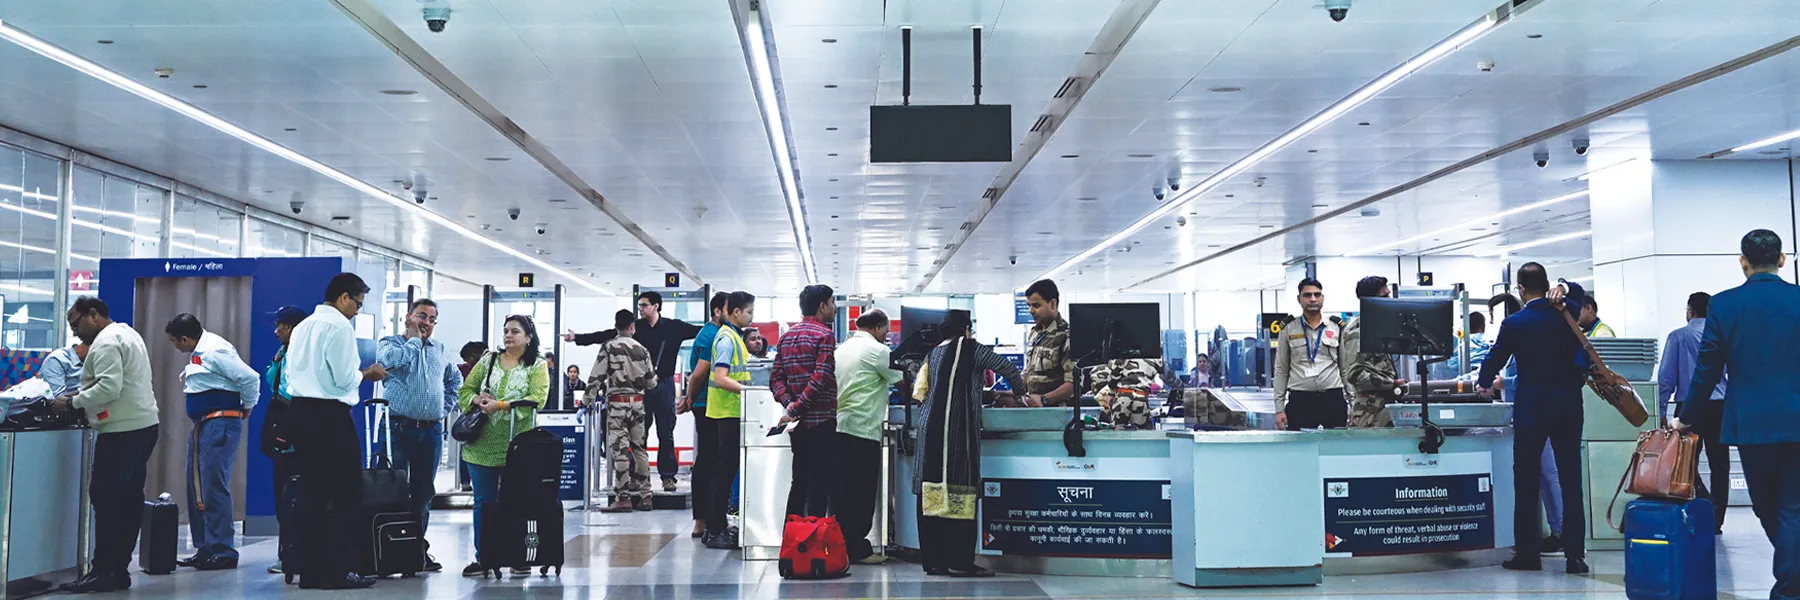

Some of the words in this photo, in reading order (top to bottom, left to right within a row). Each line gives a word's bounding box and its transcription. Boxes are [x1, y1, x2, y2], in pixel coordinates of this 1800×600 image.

[204, 261, 224, 270] महिला
[522, 276, 529, 284] R
[669, 276, 676, 284] Q
[1270, 320, 1280, 334] 6
[1056, 486, 1094, 502] सूचना
[1395, 486, 1448, 498] Information
[1008, 510, 1022, 518] कृपया
[1025, 510, 1039, 518] सुरक्षा
[1071, 510, 1078, 518] के
[1095, 510, 1112, 518] विनम्र
[1338, 508, 1361, 516] Please
[1362, 508, 1372, 516] be
[1372, 507, 1405, 516] courteous
[1406, 506, 1422, 514] when
[1424, 504, 1444, 514] dealing
[1445, 504, 1456, 512] with
[1457, 503, 1476, 512] security
[1476, 502, 1486, 510] staff
[1029, 524, 1036, 532] की
[1136, 527, 1142, 535] के
[1354, 527, 1368, 536] Any
[1368, 526, 1385, 535] form
[1386, 526, 1394, 534] of
[1394, 525, 1416, 534] threat,
[1417, 524, 1436, 533] verbal
[1436, 524, 1452, 532] abuse
[1460, 522, 1478, 530] violence
[1096, 536, 1114, 544] सकती
[1382, 536, 1401, 544] could
[1402, 534, 1420, 544] result
[1421, 534, 1427, 542] in
[1428, 533, 1460, 544] prosecution
